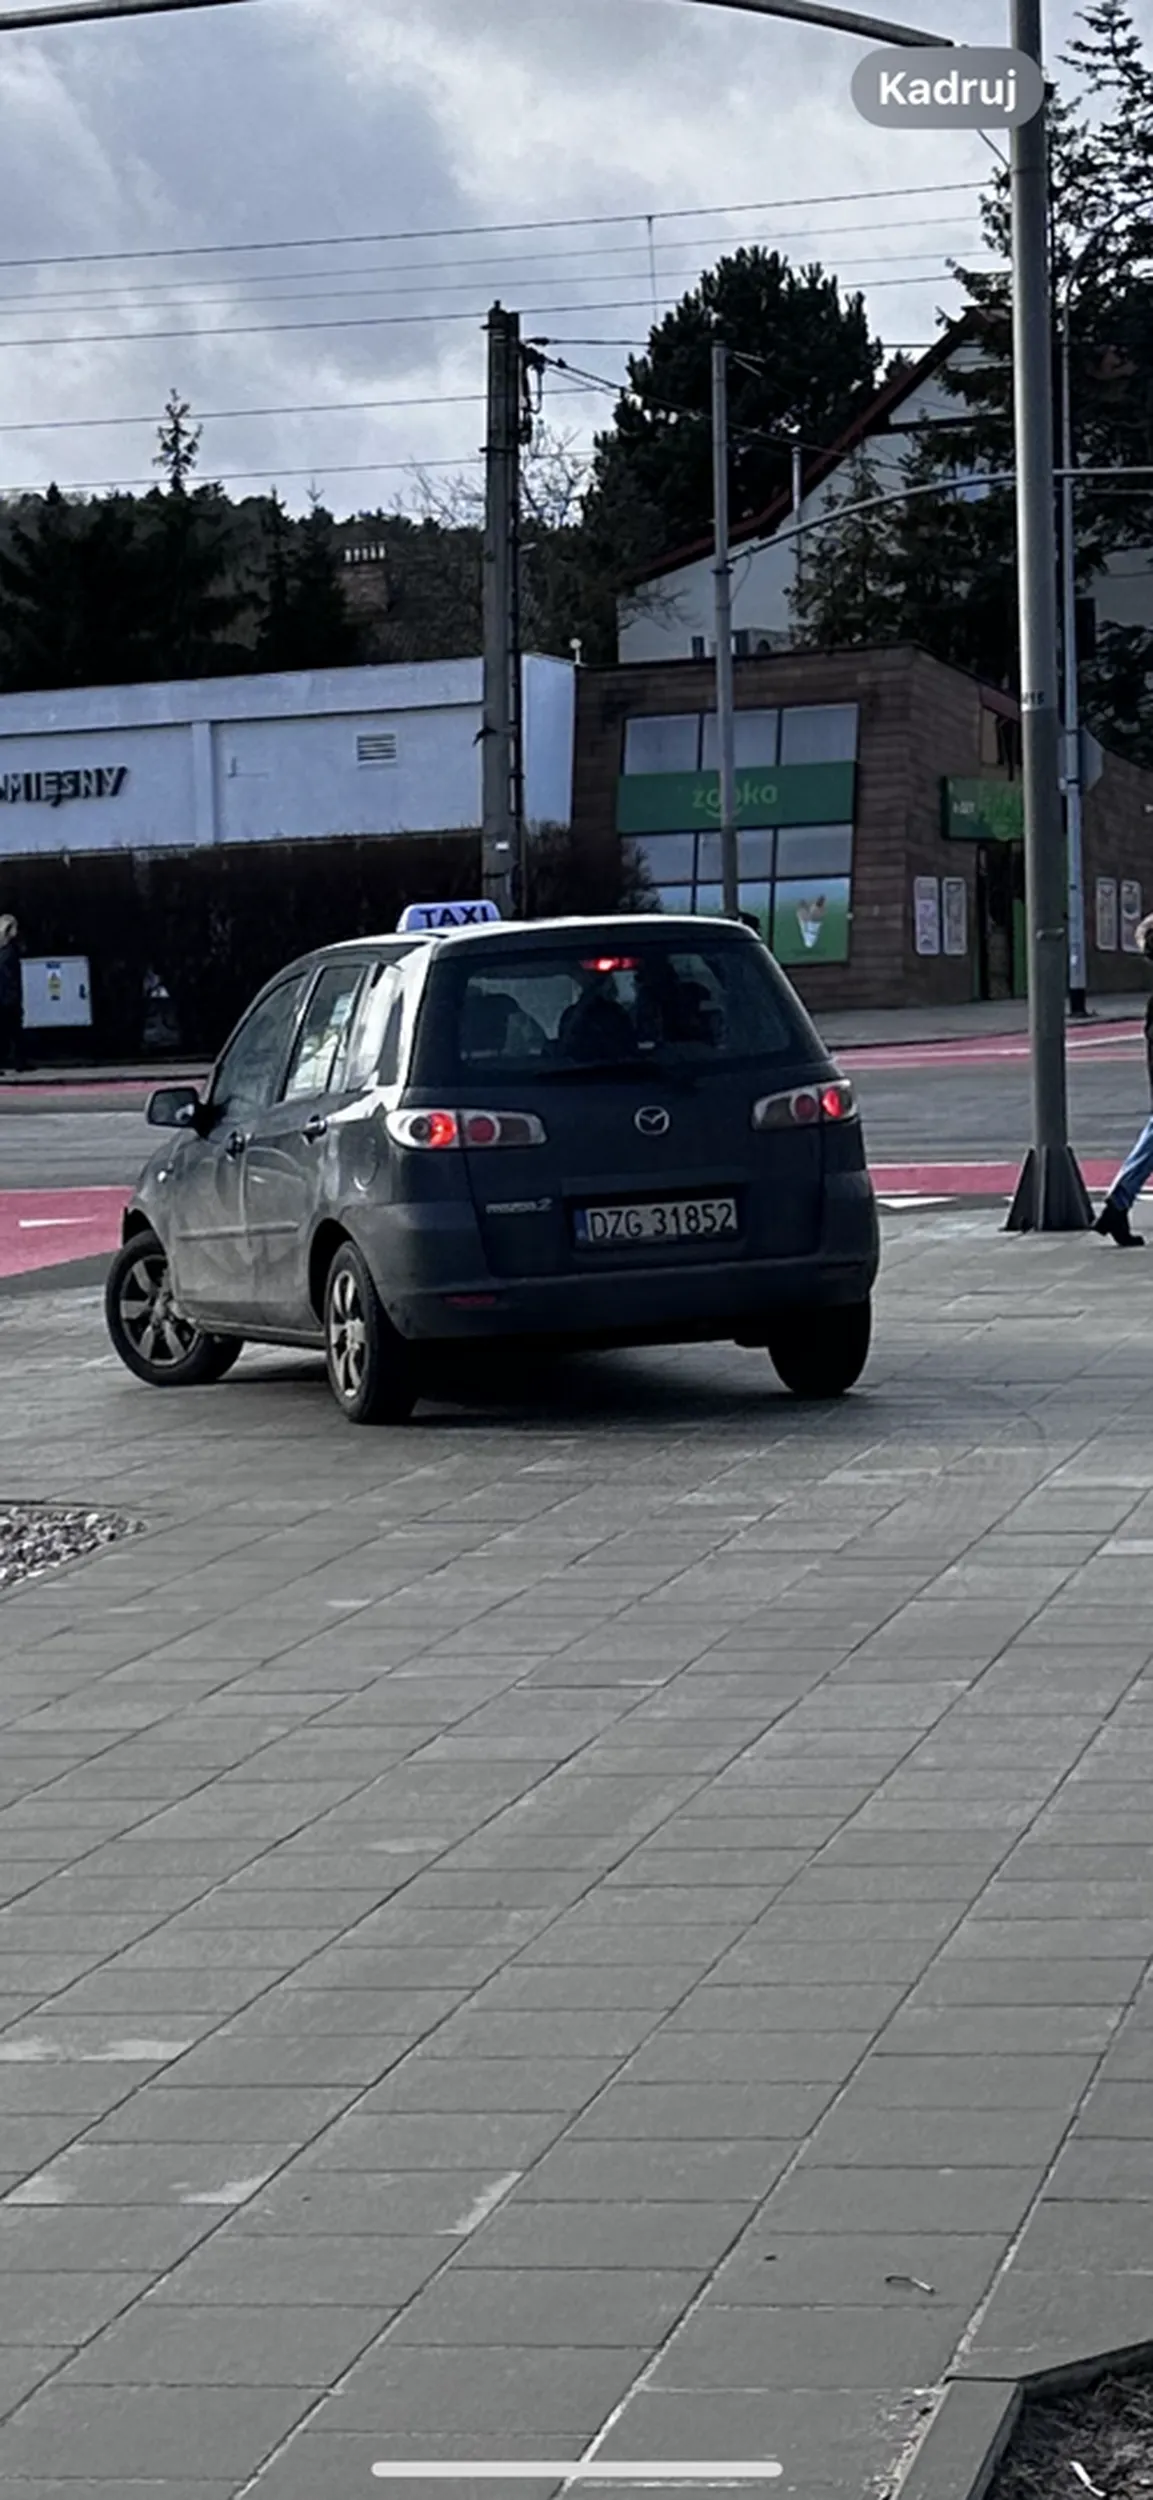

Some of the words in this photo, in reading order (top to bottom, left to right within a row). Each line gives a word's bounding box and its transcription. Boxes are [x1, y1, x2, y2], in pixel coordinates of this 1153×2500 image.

[418, 906, 489, 928] TAXI
[590, 1210, 643, 1241] DZG
[651, 1203, 734, 1236] 31852
